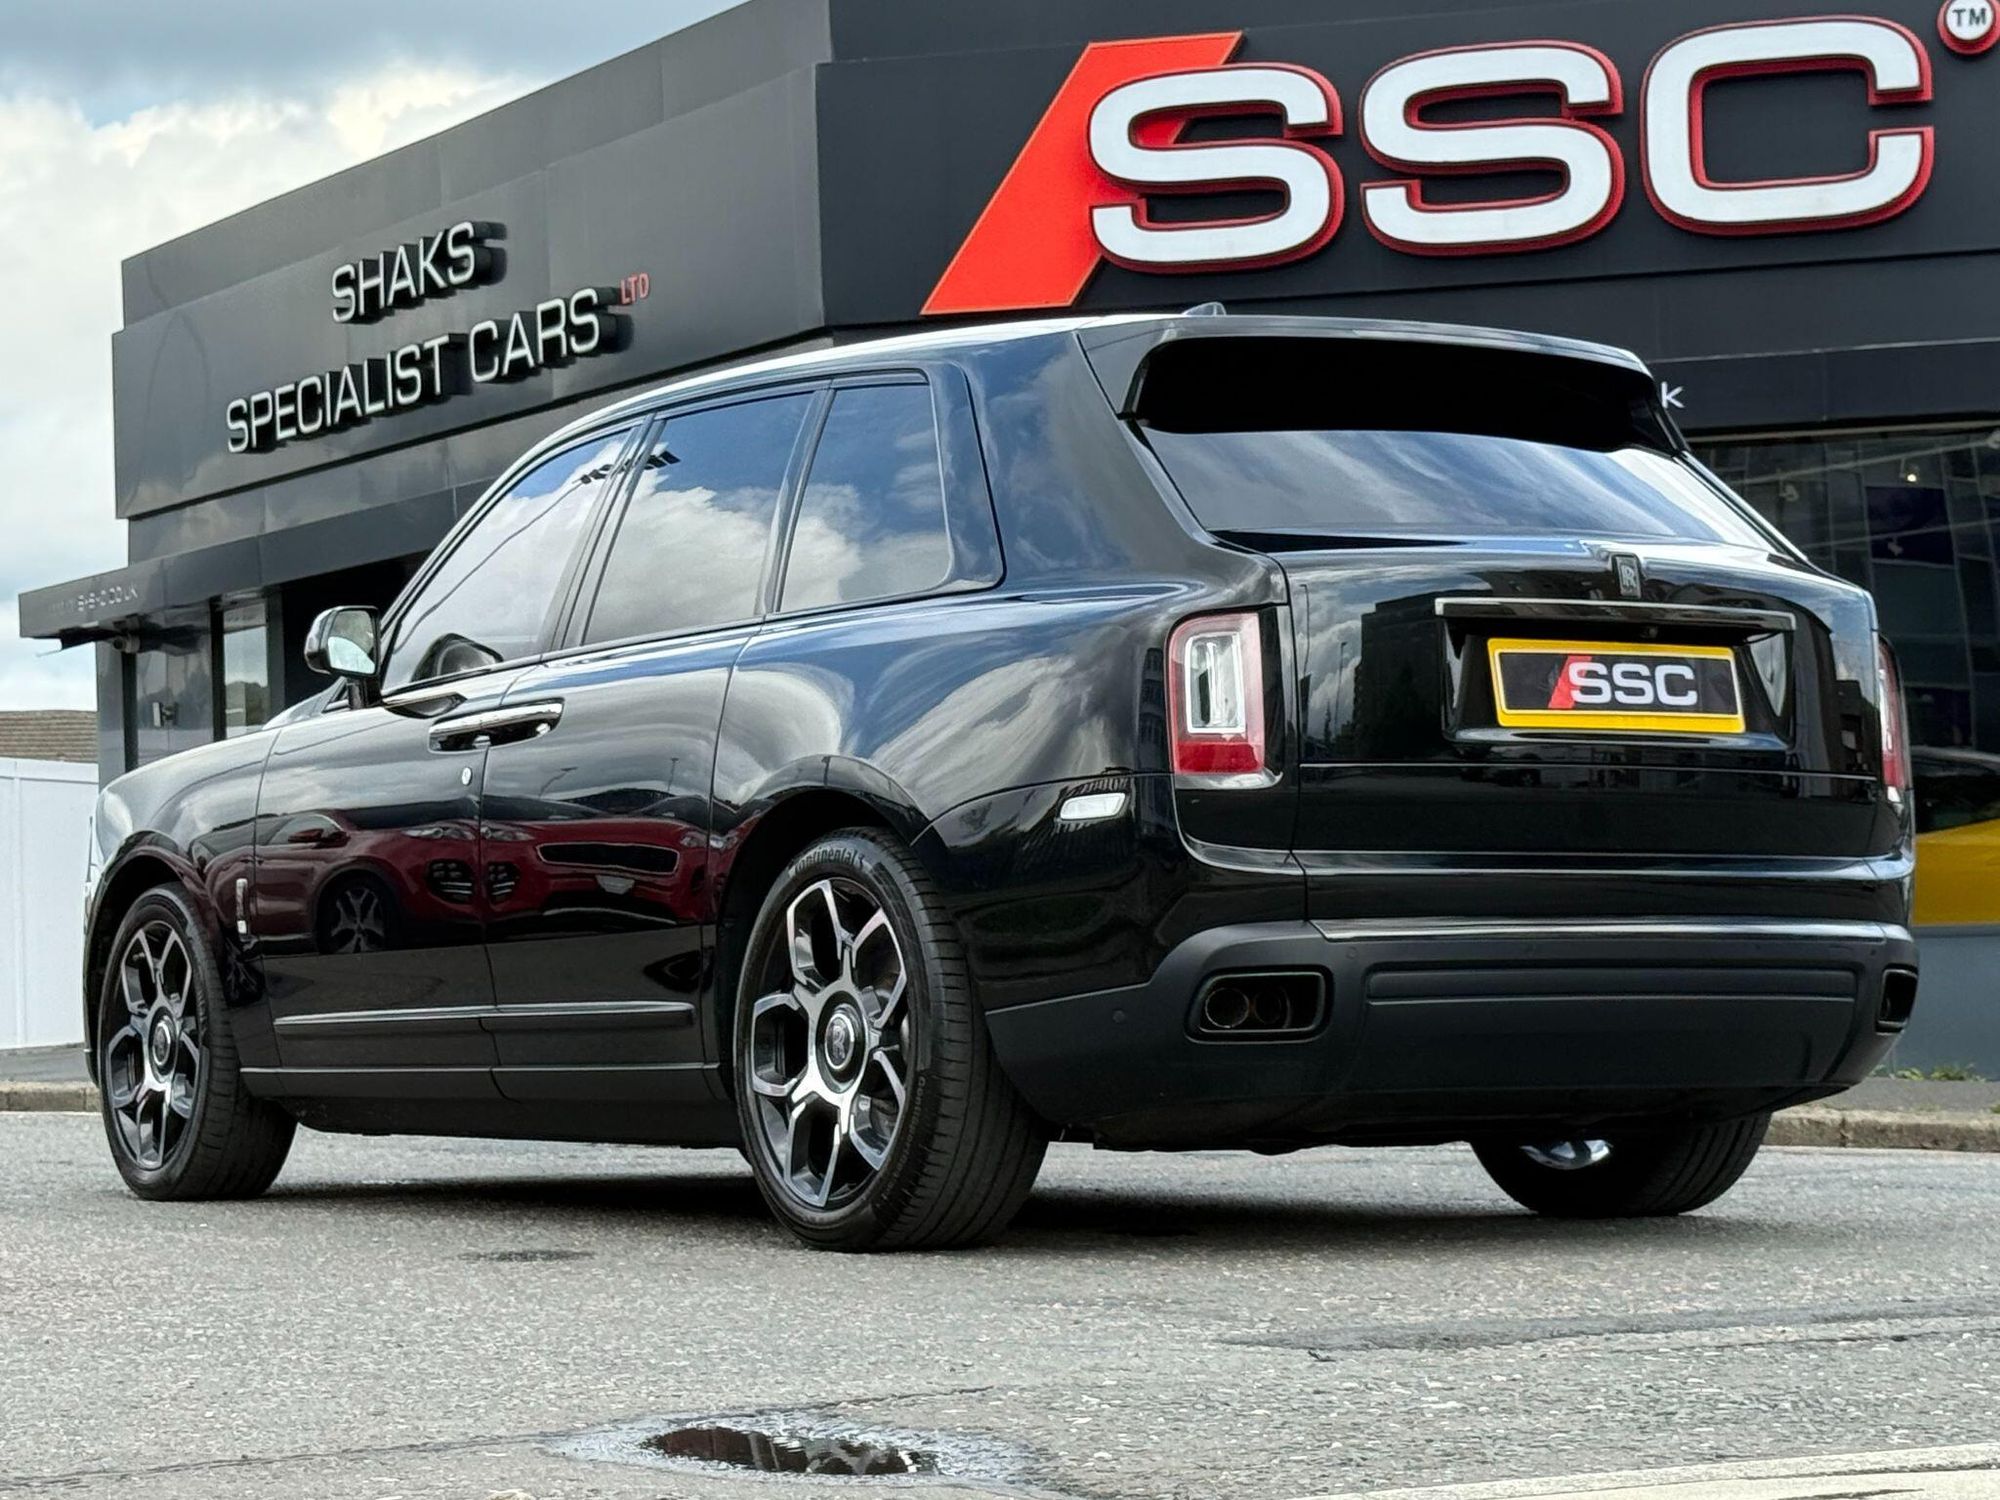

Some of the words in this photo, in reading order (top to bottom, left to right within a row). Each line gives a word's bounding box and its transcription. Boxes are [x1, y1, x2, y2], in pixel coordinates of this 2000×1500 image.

[1087, 15, 1933, 274] SSC
[1952, 7, 1987, 27] TM
[332, 220, 476, 323] SHAKS
[226, 334, 450, 453] SPECIALIST
[468, 287, 601, 384] CARS
[620, 273, 651, 305] LTD
[1567, 661, 1698, 706] SSC
